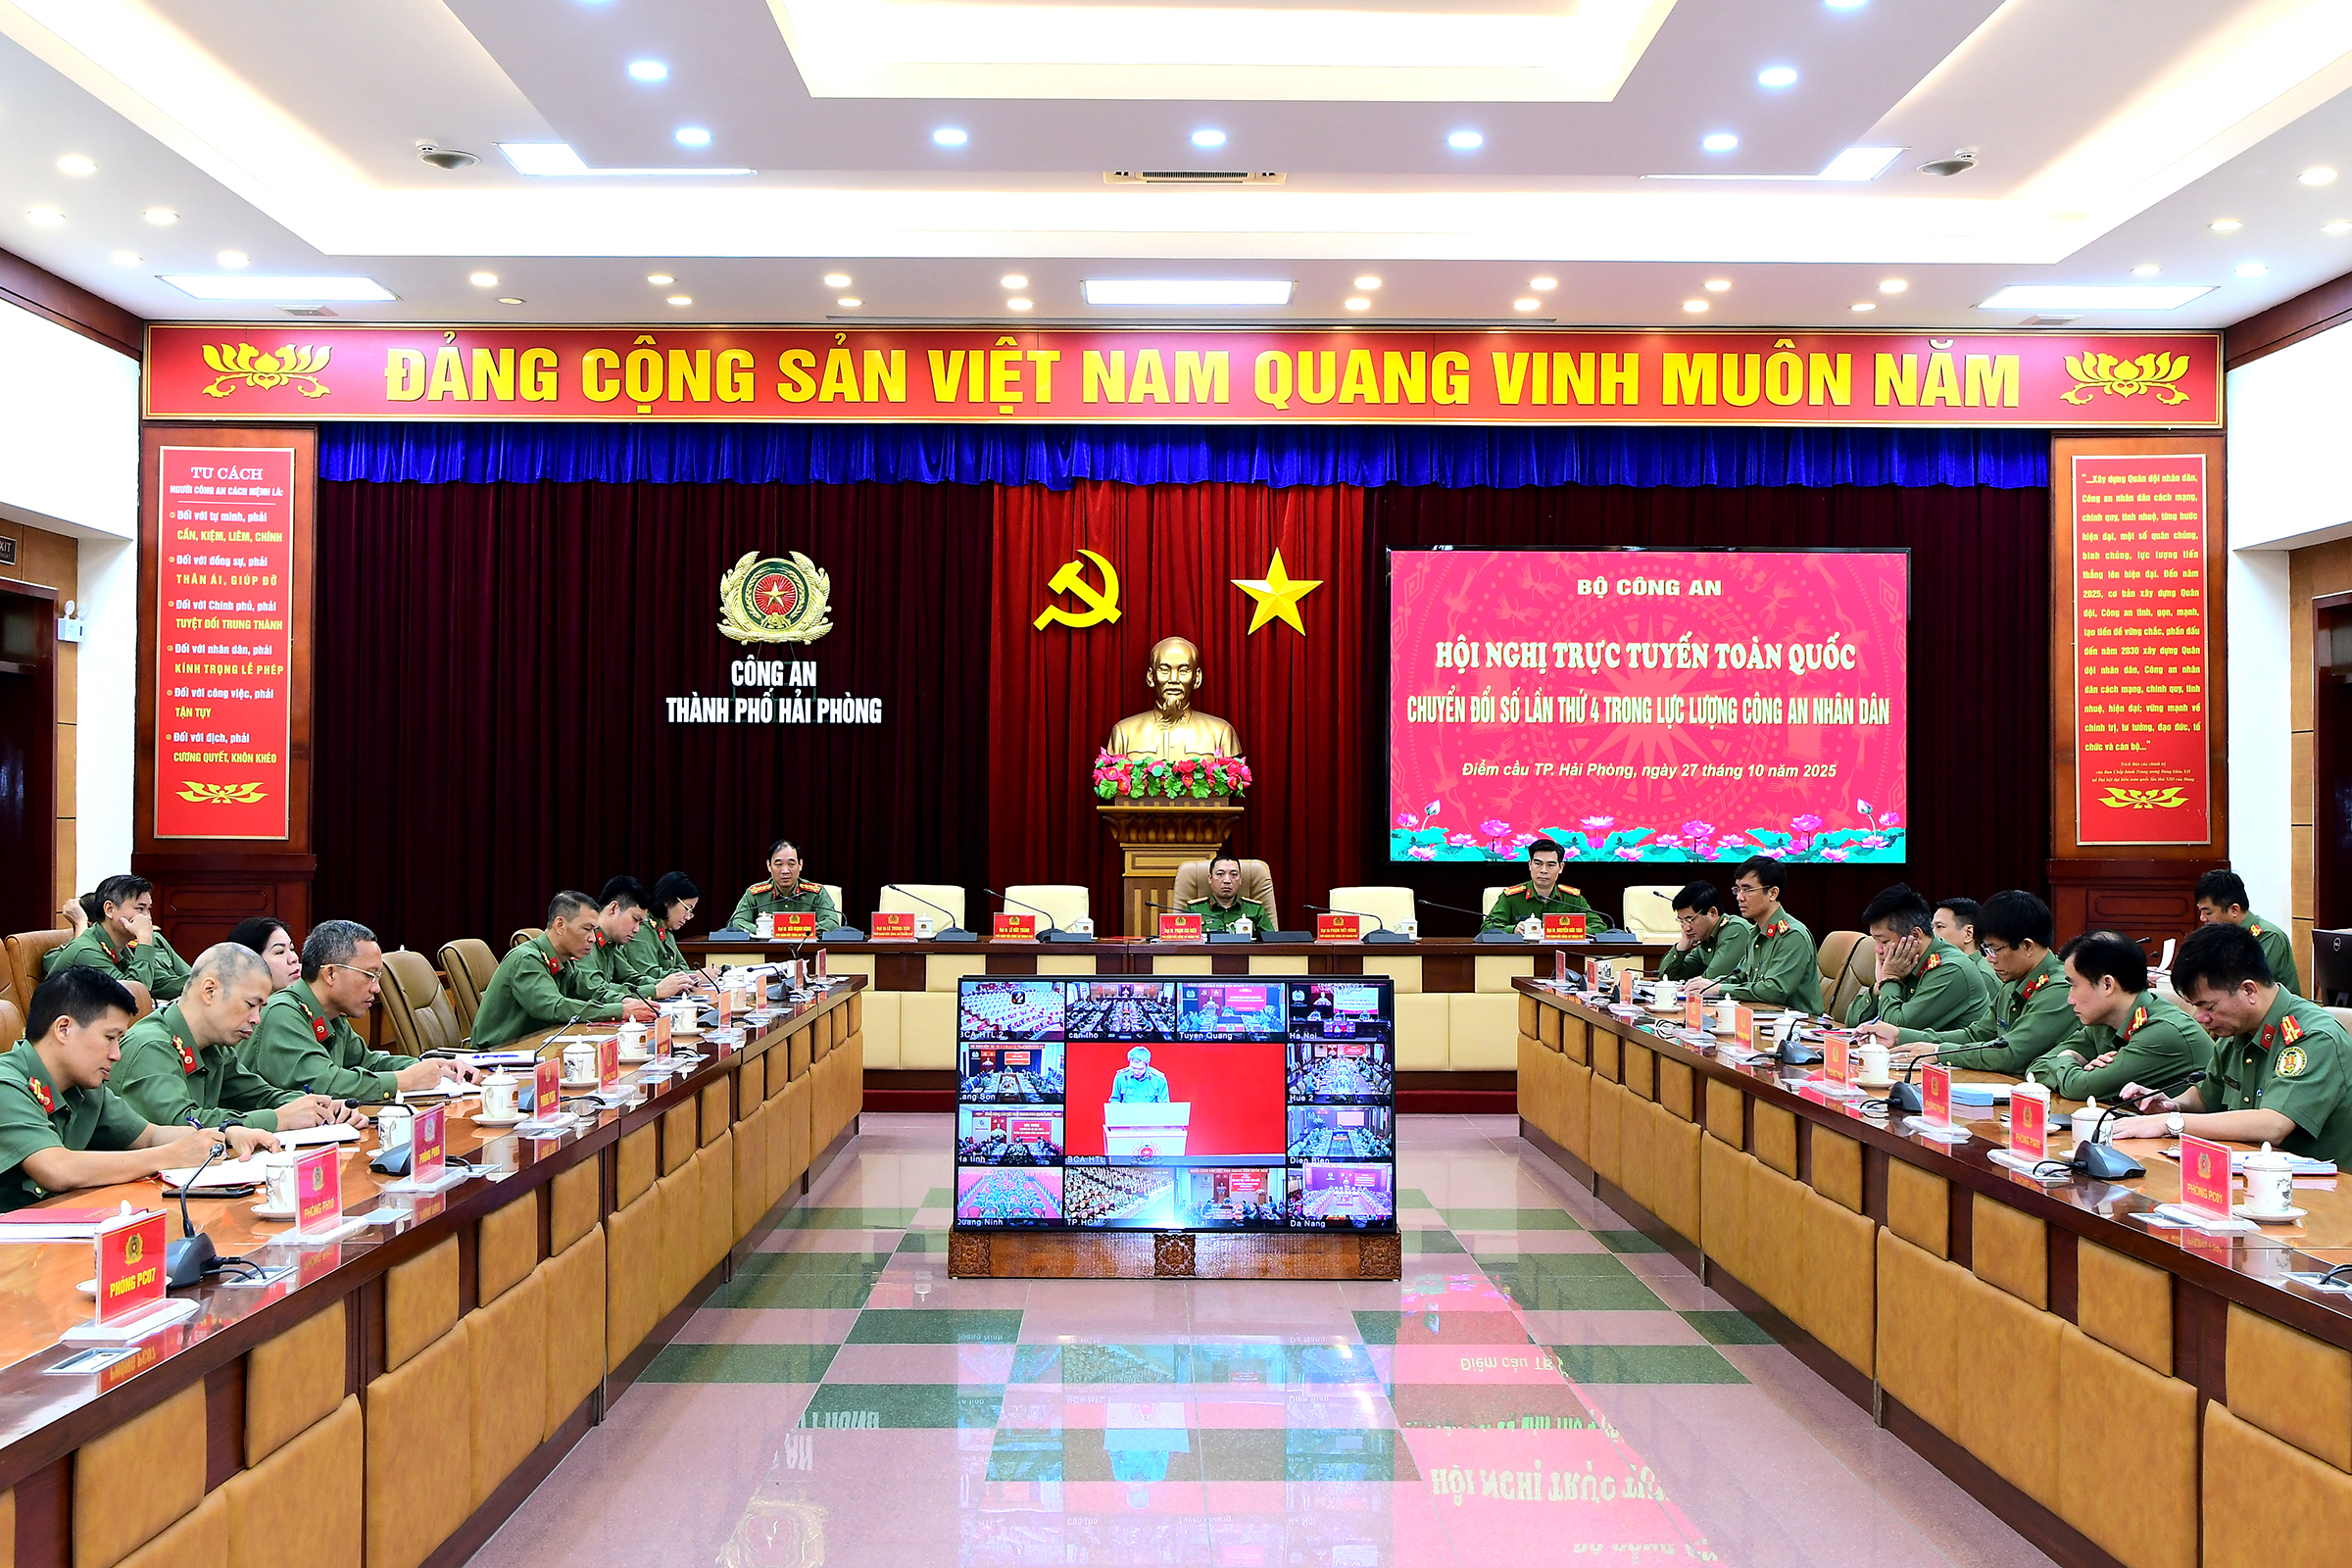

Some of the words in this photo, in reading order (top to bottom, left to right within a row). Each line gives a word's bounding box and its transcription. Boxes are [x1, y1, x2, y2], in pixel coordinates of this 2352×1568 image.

[385, 331, 559, 403] ĐẢNG
[582, 334, 756, 414] CỘNG
[776, 332, 906, 404] SẢN
[928, 335, 1062, 414] VIỆT
[1082, 349, 1230, 404] NAM
[1254, 349, 1471, 411] QUANG
[1491, 352, 1640, 406] VINH
[1661, 339, 1853, 407] MUÔN
[1873, 337, 2021, 409] NĂM
[0, 541, 12, 553] XIT
[1578, 576, 1608, 598] BỘ
[1617, 576, 1680, 595] CÔNG
[1689, 580, 1721, 596] AN
[254, 618, 282, 630] THÀNH
[1436, 634, 1480, 673] HỘI
[1485, 642, 1547, 674] NGHỊ
[1552, 640, 1620, 674] TRỰC
[1626, 631, 1709, 668] TUYẾN
[1714, 636, 1783, 669] TOÀN
[1788, 632, 1855, 675] QUỐC
[731, 655, 783, 686] CÔNG
[789, 661, 816, 686] AN
[666, 692, 729, 722] THÀNH
[735, 688, 773, 723] PHỐ
[779, 689, 810, 723] HẢI
[817, 692, 882, 723] PHÒNG
[1407, 685, 1465, 722] CHUYỂN
[1470, 685, 1494, 723] ĐỔI
[1500, 687, 1520, 723] SỐ
[1525, 687, 1553, 722] LẦN
[1557, 689, 1588, 723] THỨ
[1591, 697, 1599, 723] 4
[1603, 696, 1652, 723] TRONG
[1657, 694, 1685, 729] LỰC
[1690, 694, 1738, 730] LƯỢNG
[1742, 692, 1782, 724] CÔNG
[1788, 698, 1808, 724] AN
[1813, 692, 1853, 724] NHÂN
[1859, 692, 1889, 724] DÂN
[1462, 760, 1499, 775] Điểm
[1503, 760, 1529, 775] cầu
[1535, 763, 1554, 775] TP.
[1559, 762, 1583, 775] Hải
[1587, 763, 1637, 779] Phòng,
[1642, 763, 1678, 779] ngày
[1682, 763, 1698, 776] 27
[1702, 763, 1743, 780] tháng
[1748, 764, 1764, 777] 10
[1768, 764, 1798, 777] năm
[1803, 764, 1837, 777] 2025
[1179, 1032, 1203, 1041] Tuyen
[1206, 1032, 1233, 1041] Quang
[2186, 1183, 2208, 1199] PHÒNG
[2208, 1190, 2223, 1204] PC01
[304, 1203, 322, 1220] PHÒNG
[1304, 1220, 1326, 1229] Nang
[110, 1275, 136, 1298] PHÒNG
[136, 1267, 157, 1289] PC07
